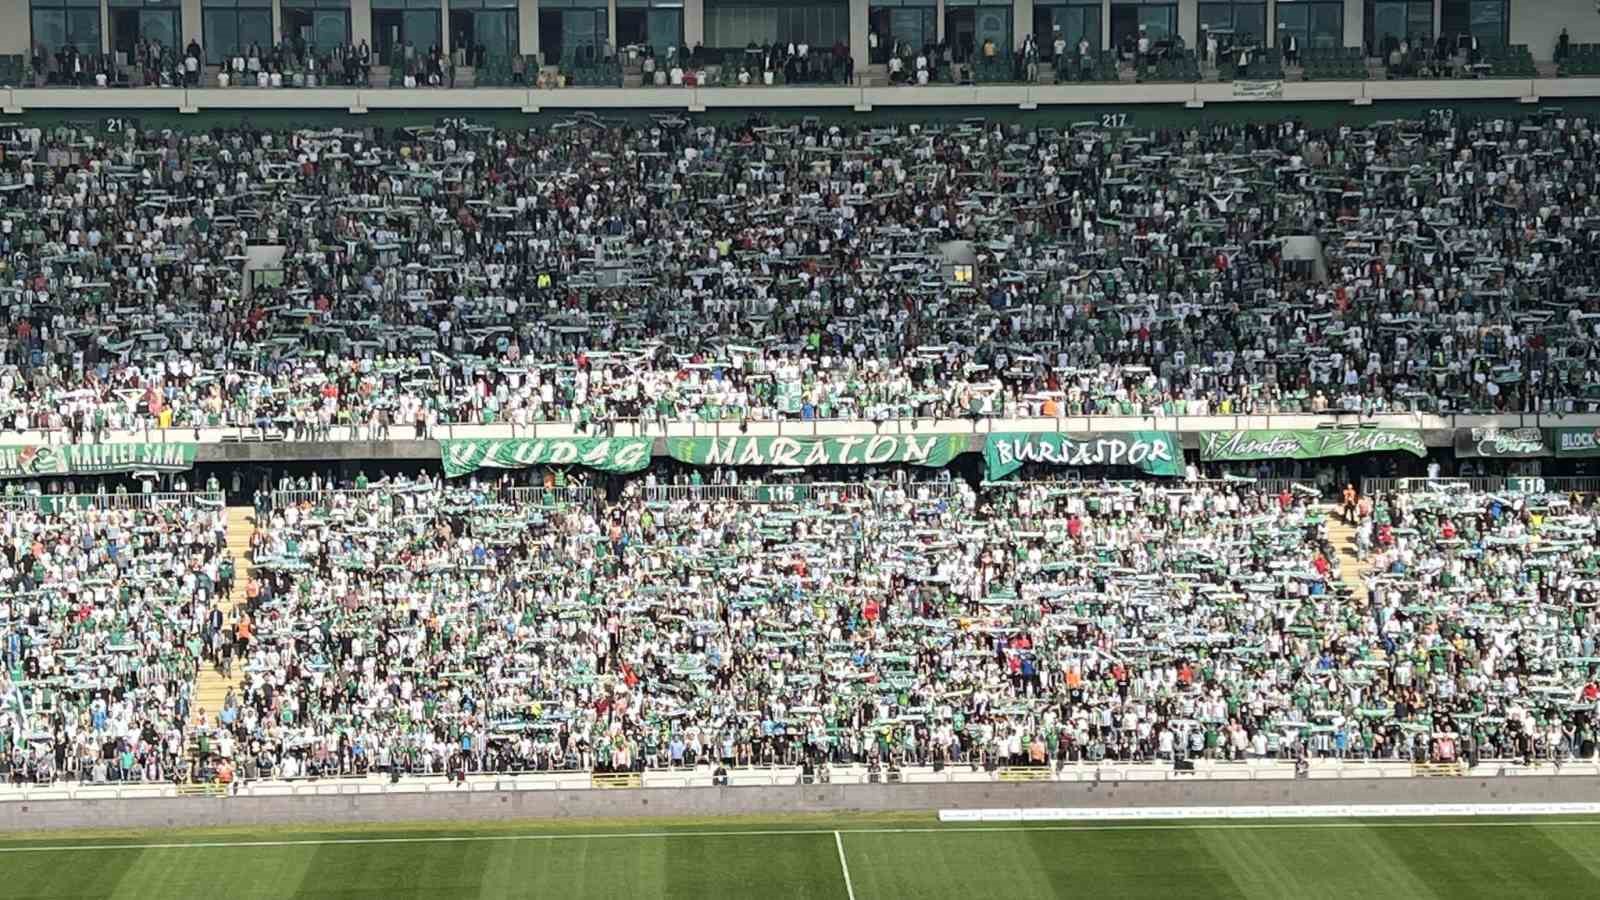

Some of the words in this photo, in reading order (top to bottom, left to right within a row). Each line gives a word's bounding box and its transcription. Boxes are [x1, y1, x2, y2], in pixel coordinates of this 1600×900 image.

[1102, 113, 1127, 127] 217
[142, 443, 185, 465] SANA
[705, 436, 938, 465] MARATON
[995, 439, 1172, 465] BURSASPOR
[768, 486, 794, 501] 116
